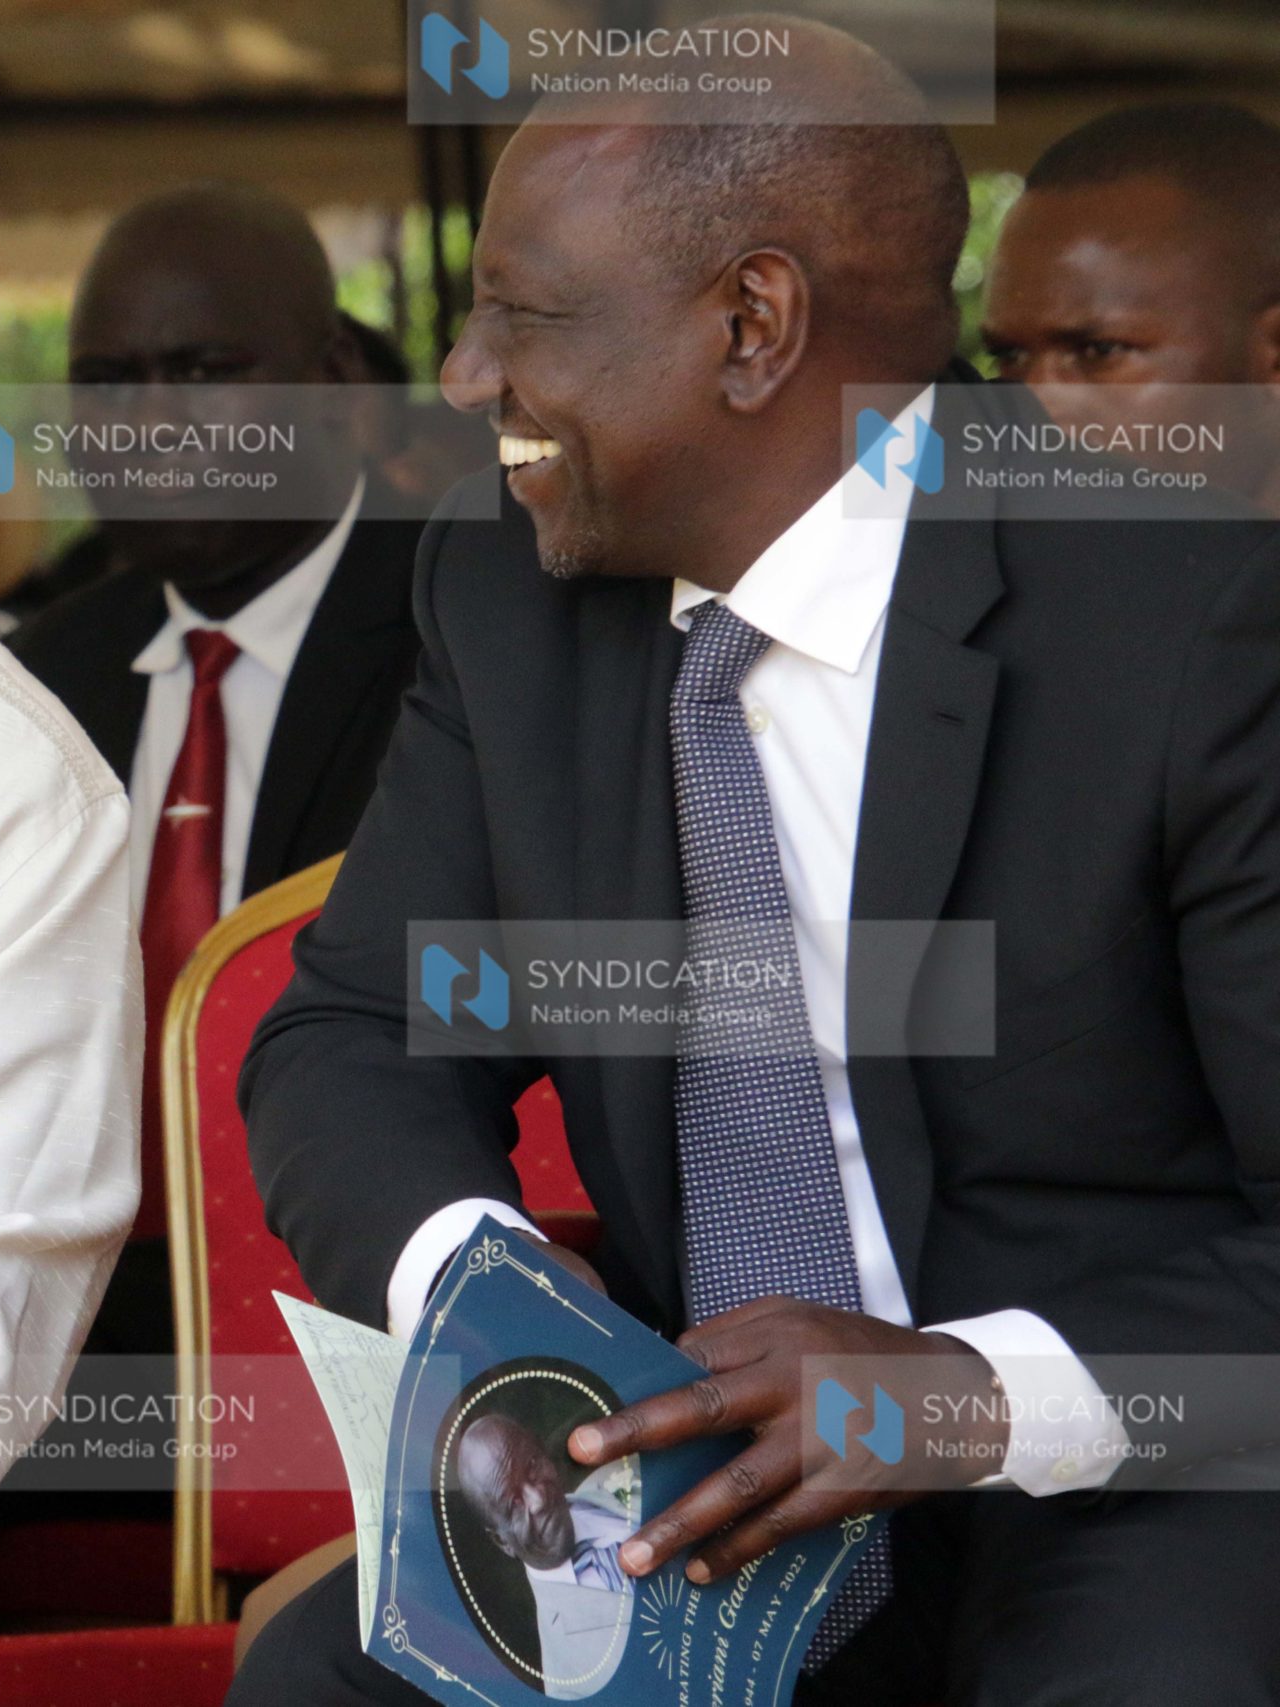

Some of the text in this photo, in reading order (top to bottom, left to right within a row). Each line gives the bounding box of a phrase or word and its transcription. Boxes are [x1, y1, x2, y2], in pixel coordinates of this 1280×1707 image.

[719, 1547, 776, 1630] Gach
[752, 1640, 764, 1661] 07
[759, 1594, 782, 1637] MAY
[779, 1554, 807, 1592] 2022
[679, 1588, 702, 1707] RATING THE
